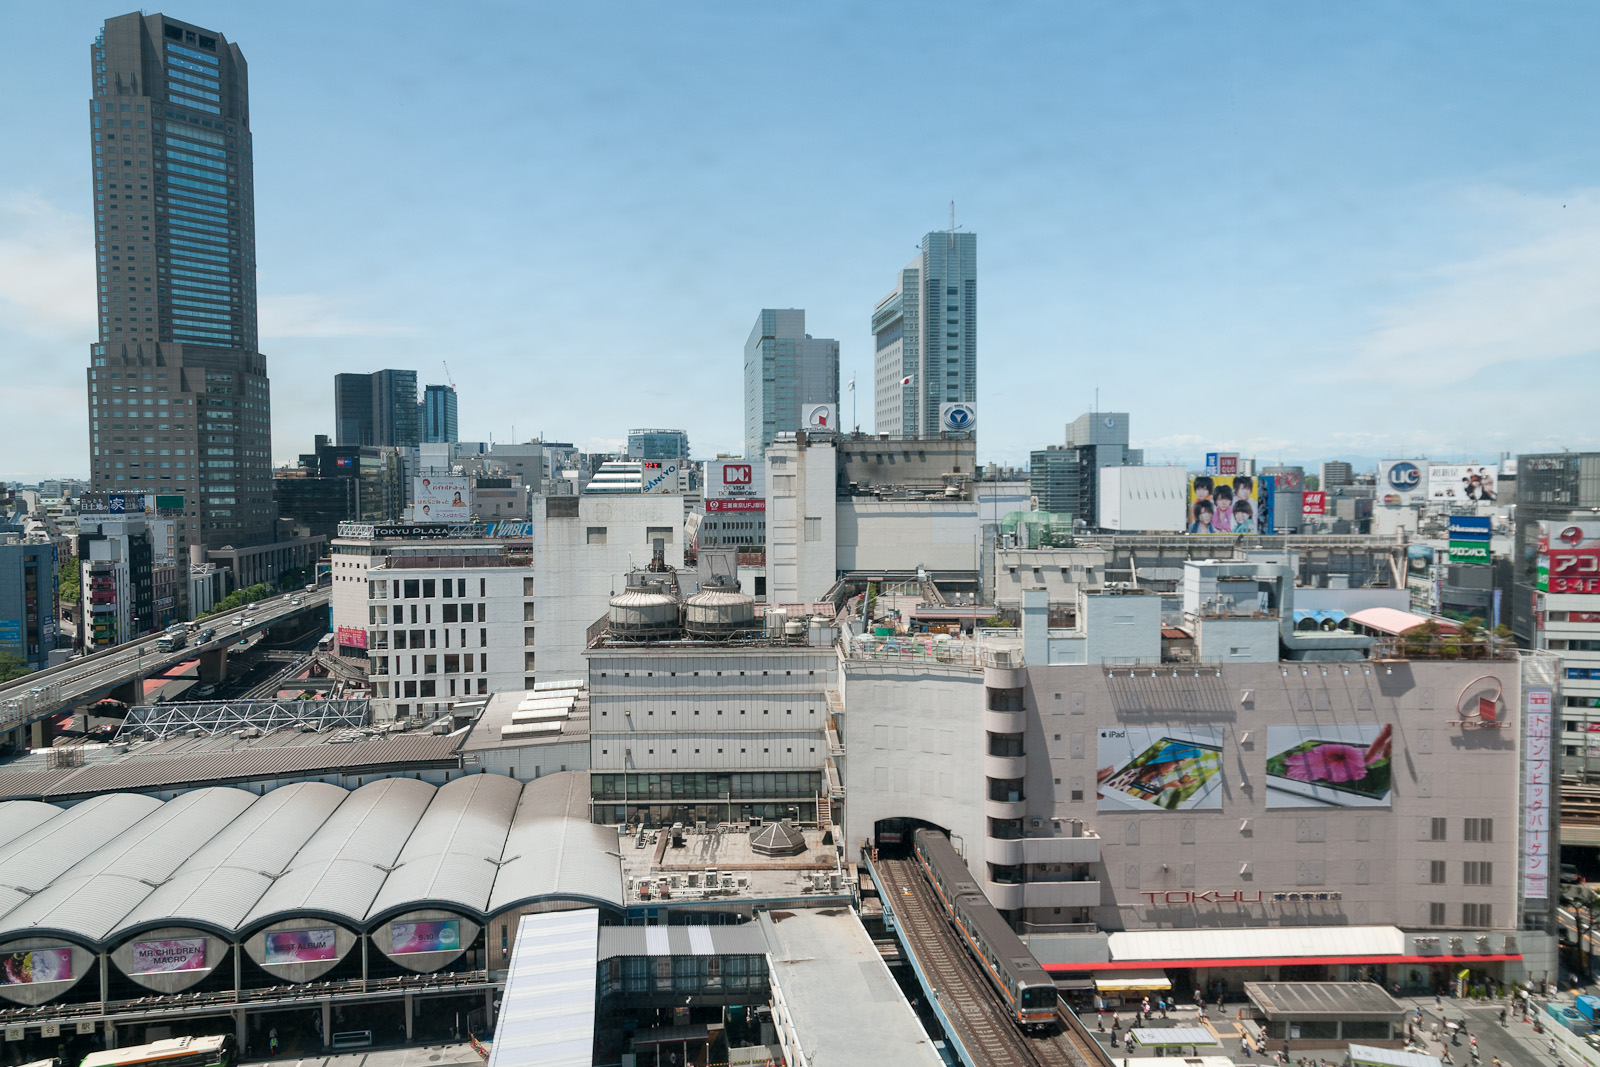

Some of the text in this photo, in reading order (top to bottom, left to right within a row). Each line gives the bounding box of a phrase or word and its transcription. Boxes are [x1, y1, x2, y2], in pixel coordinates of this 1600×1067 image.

[643, 465, 676, 493] SANKYO
[726, 467, 749, 482] DC
[413, 526, 448, 534] PLAZA
[1140, 890, 1264, 903] TOKYU
[139, 946, 201, 957] MR.CHILDREN
[297, 942, 327, 950] ALBUM
[153, 955, 187, 965] MACRO
